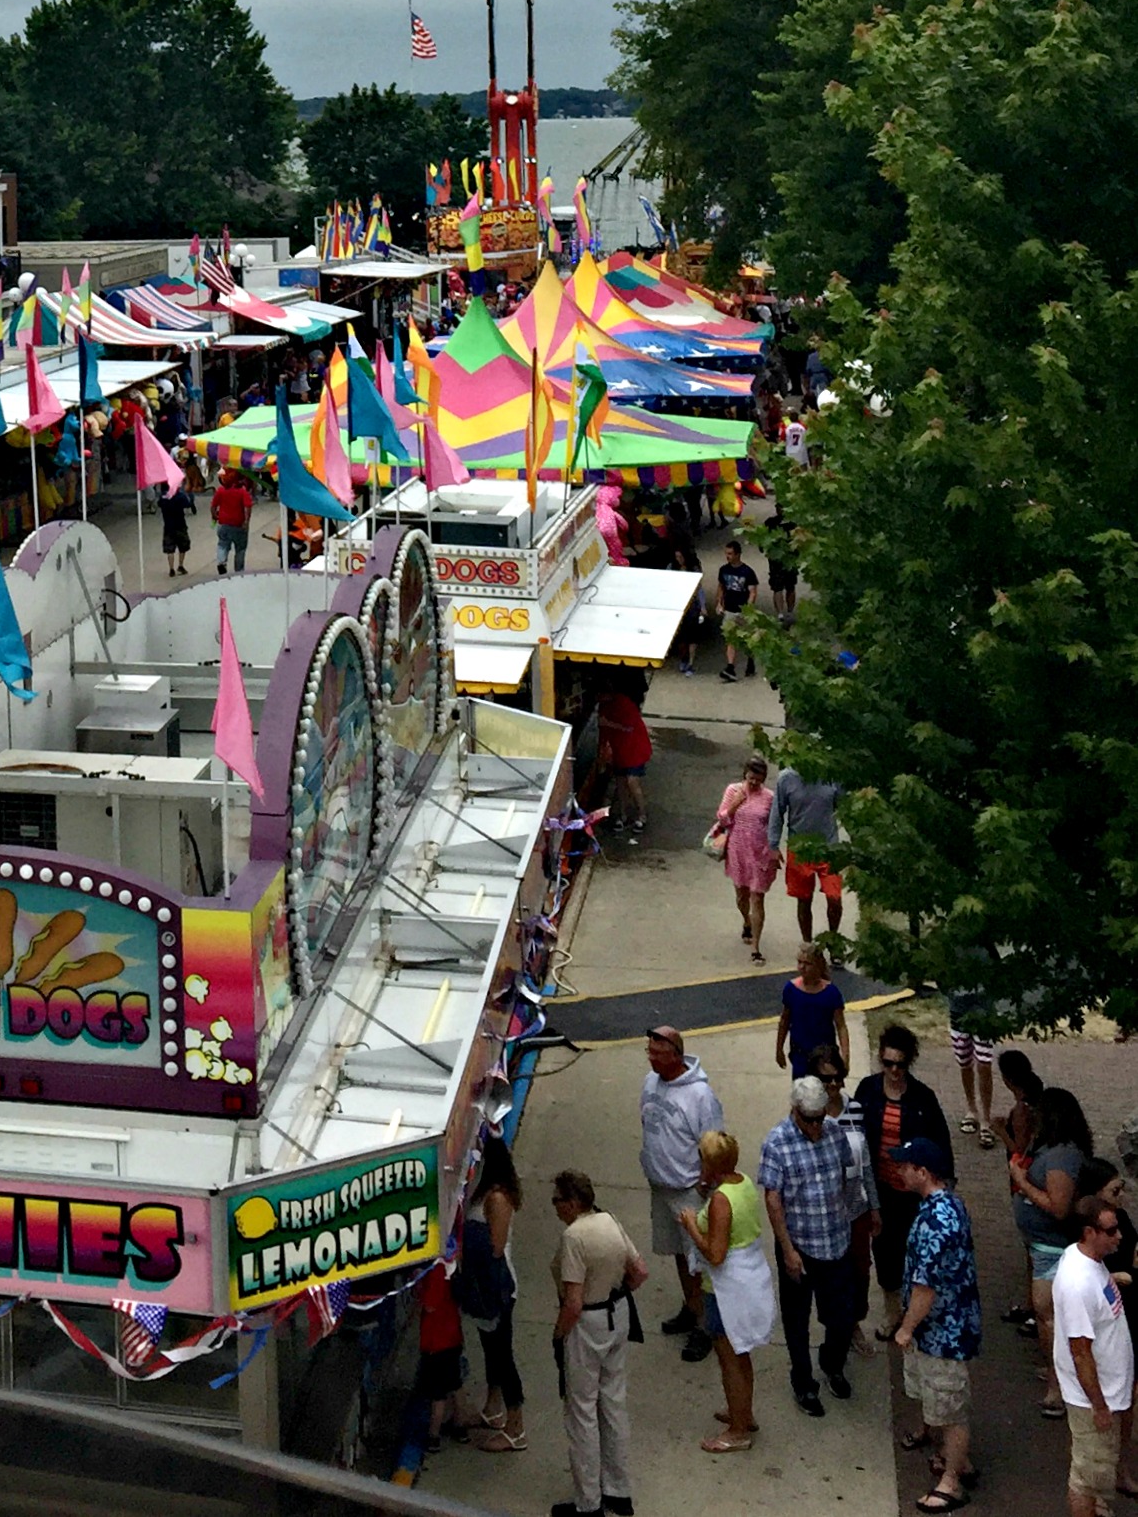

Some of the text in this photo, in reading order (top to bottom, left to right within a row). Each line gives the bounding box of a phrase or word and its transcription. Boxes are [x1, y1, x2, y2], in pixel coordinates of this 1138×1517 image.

[792, 434, 800, 446] 7
[435, 557, 521, 585] DOGS
[7, 983, 151, 1044] DOGS
[280, 1160, 427, 1230] FRESH SQUEEZED
[240, 1206, 429, 1294] LEMONADE
